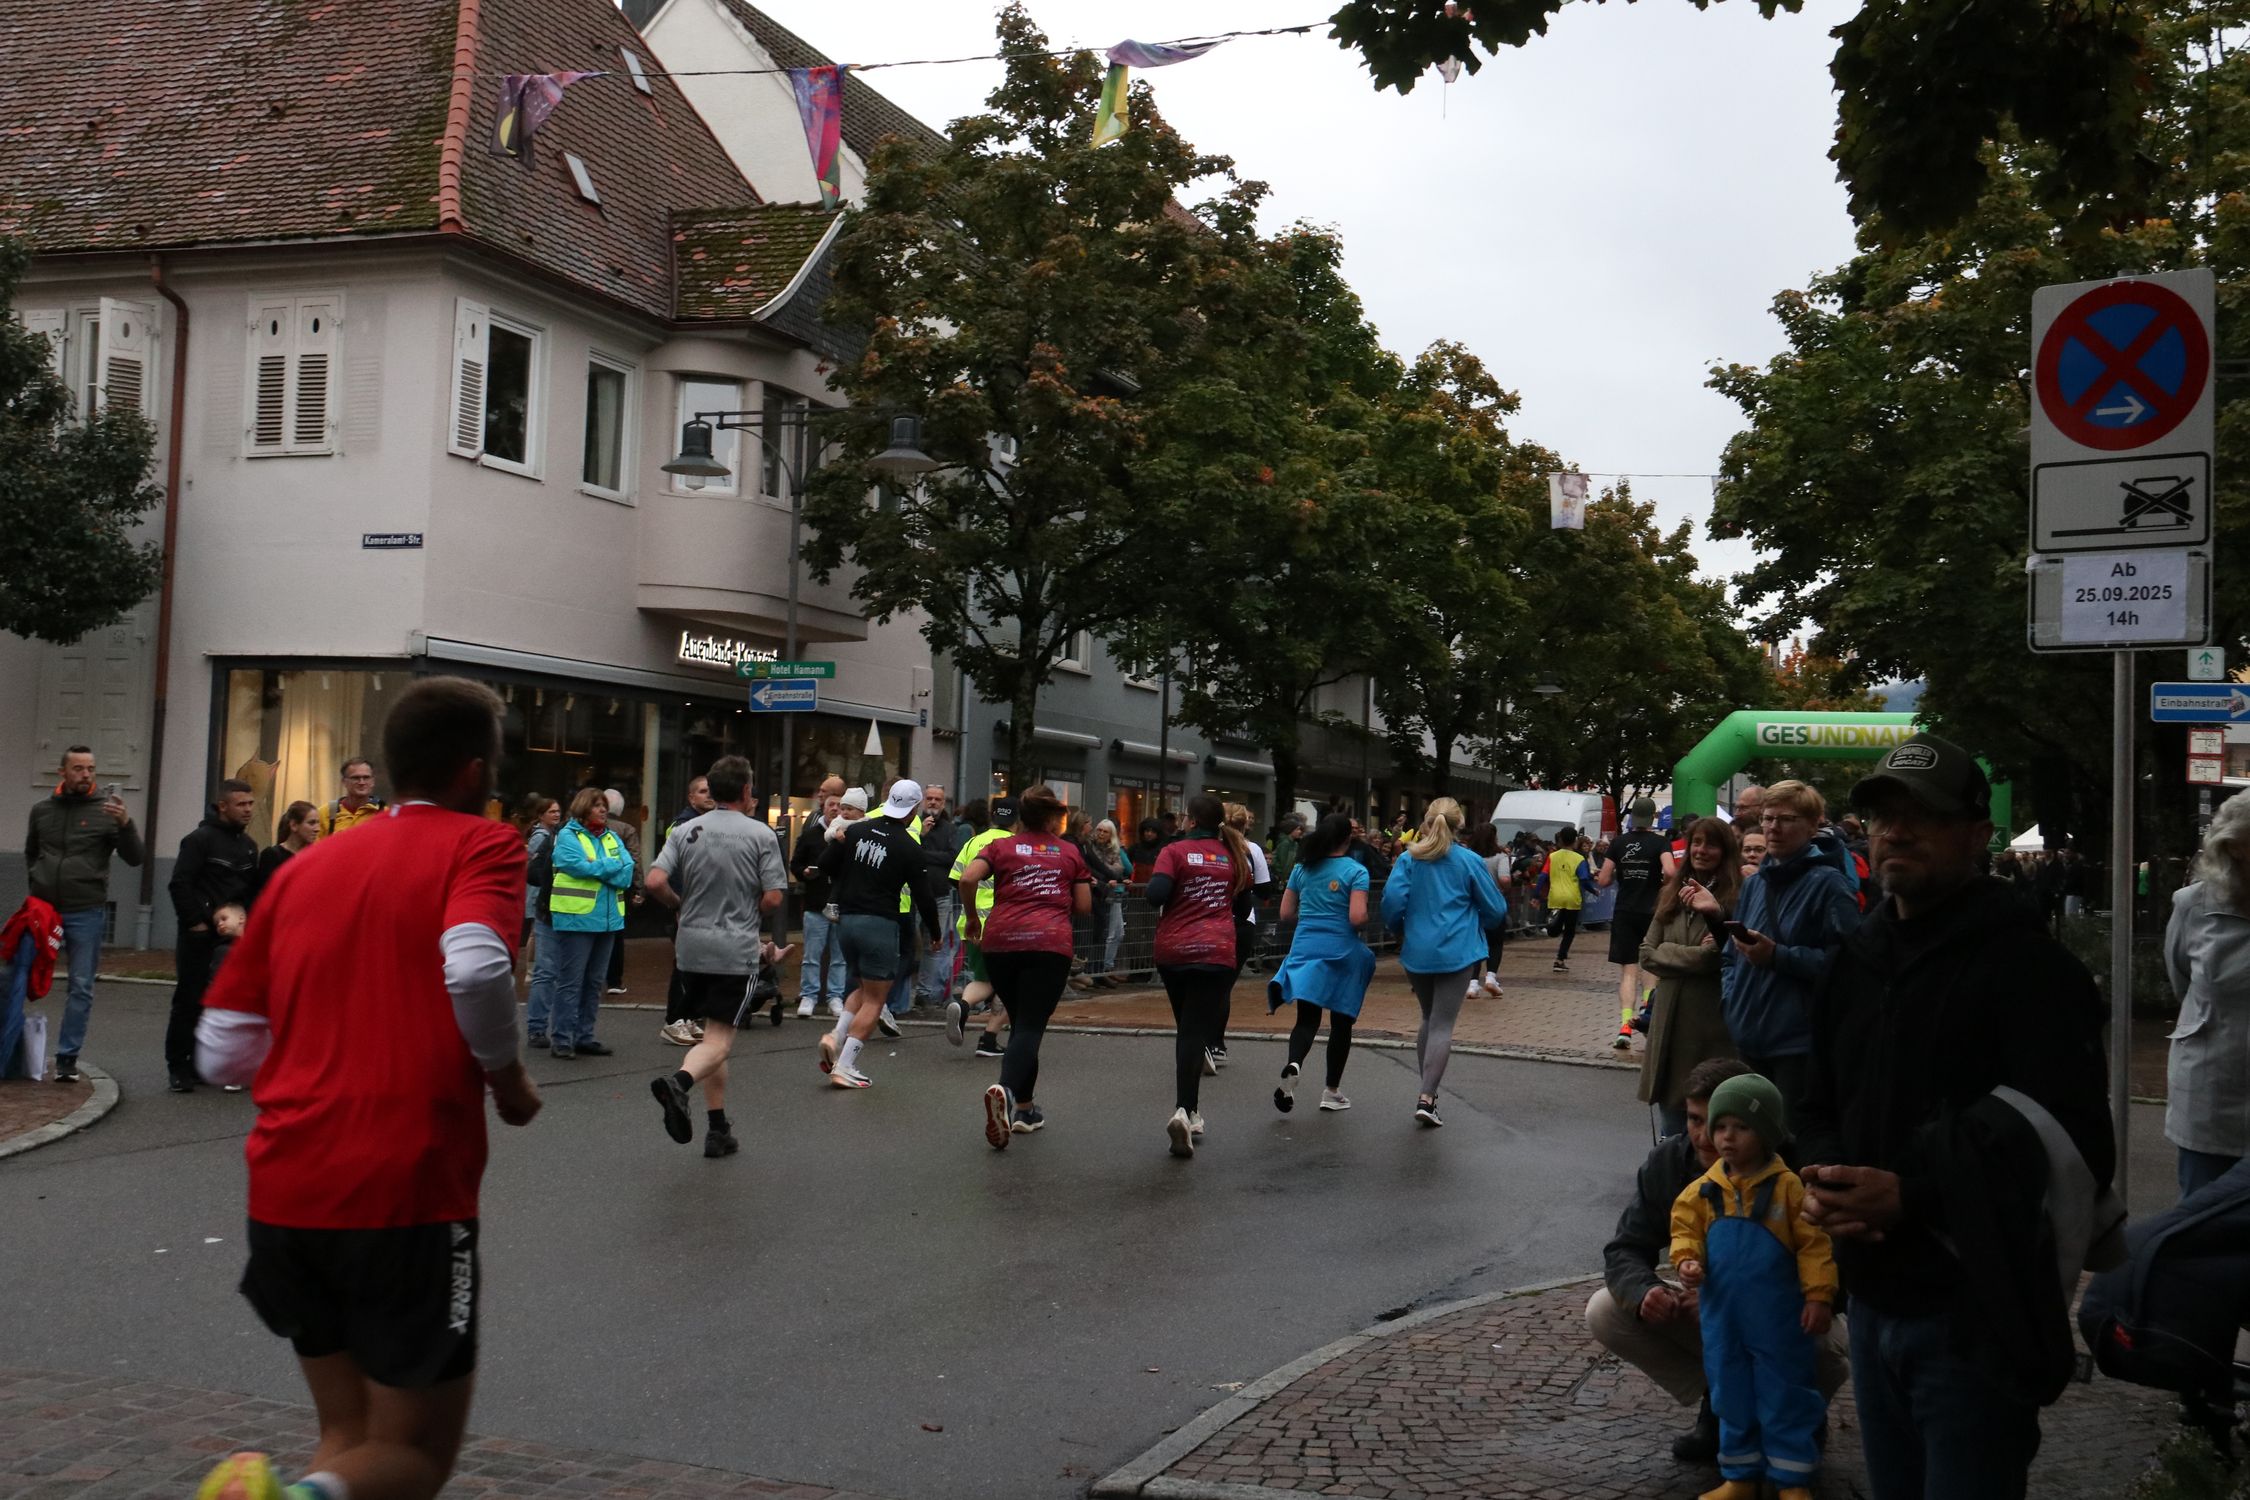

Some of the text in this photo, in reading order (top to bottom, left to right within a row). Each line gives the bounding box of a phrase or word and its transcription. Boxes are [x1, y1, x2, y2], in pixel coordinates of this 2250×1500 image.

[364, 535, 421, 545] Kameralamt-Str.
[2110, 562, 2137, 577] Ab
[2075, 585, 2173, 602] 25.09.2025
[2106, 611, 2139, 626] 14h
[770, 664, 825, 675] Hotel Hamann
[449, 1250, 472, 1335] TERREX
